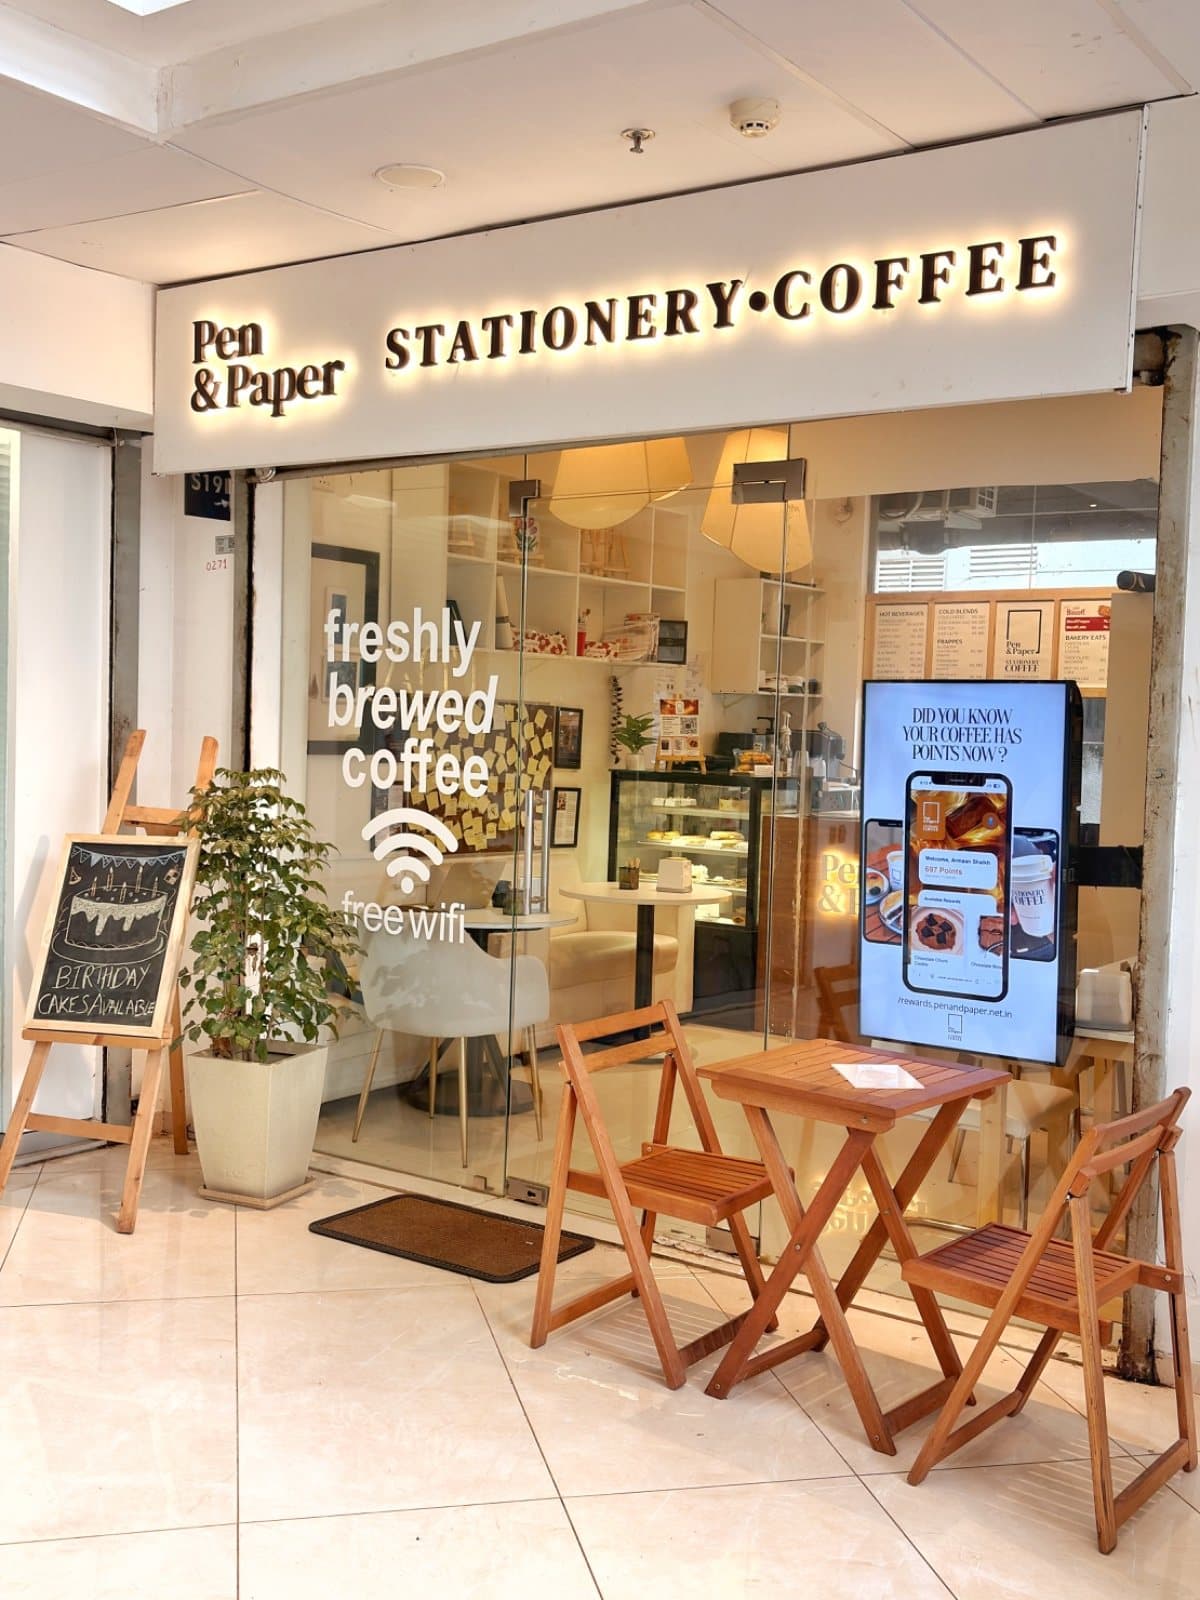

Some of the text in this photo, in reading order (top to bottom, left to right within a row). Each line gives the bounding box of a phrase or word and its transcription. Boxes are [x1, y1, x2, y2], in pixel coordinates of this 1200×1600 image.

[385, 235, 1057, 370] STATIONERY COFFEE
[192, 320, 264, 364] Pen
[206, 558, 228, 572] 0271
[324, 607, 482, 678] freshly
[1006, 641, 1021, 649] Pen
[1004, 664, 1040, 672] COFFEE
[328, 672, 499, 734] brewed
[912, 707, 1013, 725] DID YOU KNOW
[903, 725, 1022, 744] YOUR COFFEE HAS
[912, 744, 960, 761] POINTS
[342, 738, 489, 798] coffee
[939, 866, 963, 875] Points
[341, 891, 466, 944] free wifi
[52, 963, 150, 990] BIRTHDAY
[37, 993, 90, 1015] CAKES
